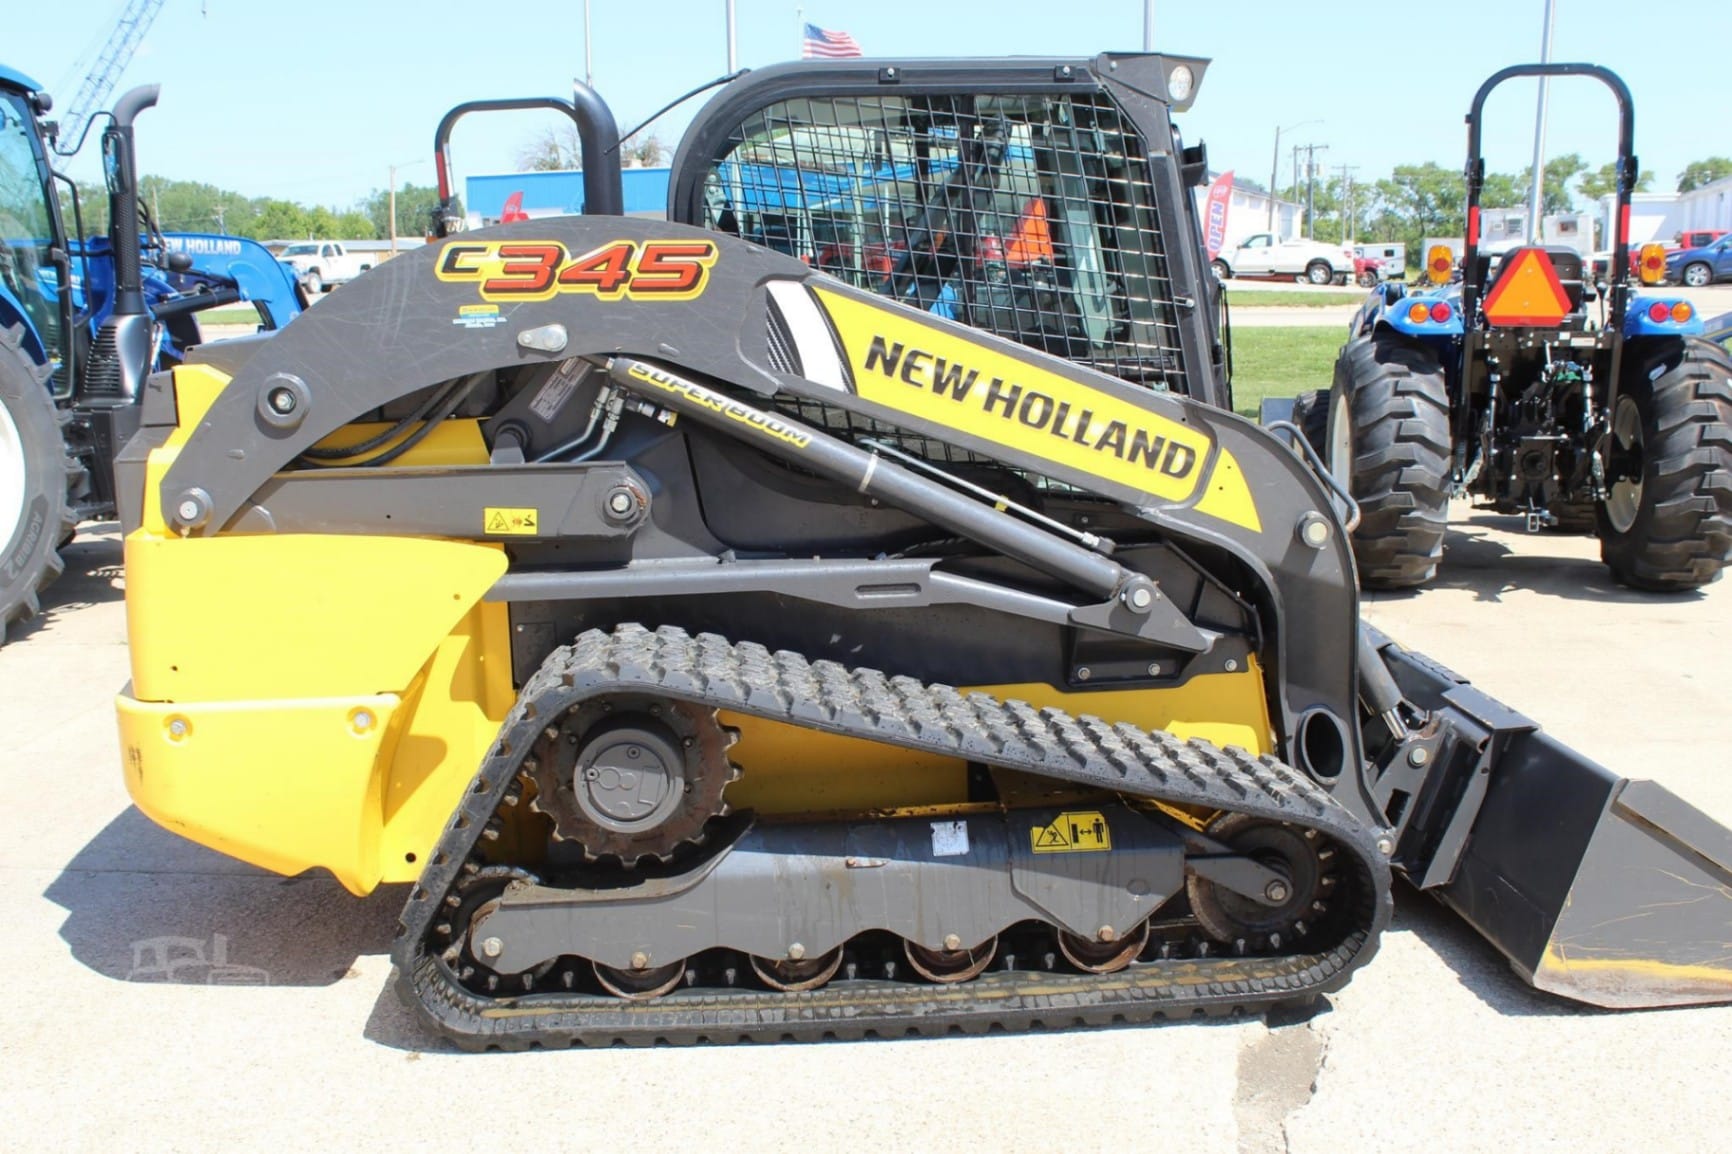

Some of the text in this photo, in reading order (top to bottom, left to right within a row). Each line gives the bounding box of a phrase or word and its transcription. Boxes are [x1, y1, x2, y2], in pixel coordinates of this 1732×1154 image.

[164, 238, 241, 255] EW HOLLAND
[1209, 201, 1224, 251] OPEN
[437, 242, 716, 297] C345
[864, 335, 1196, 479] NEW HOLLAND
